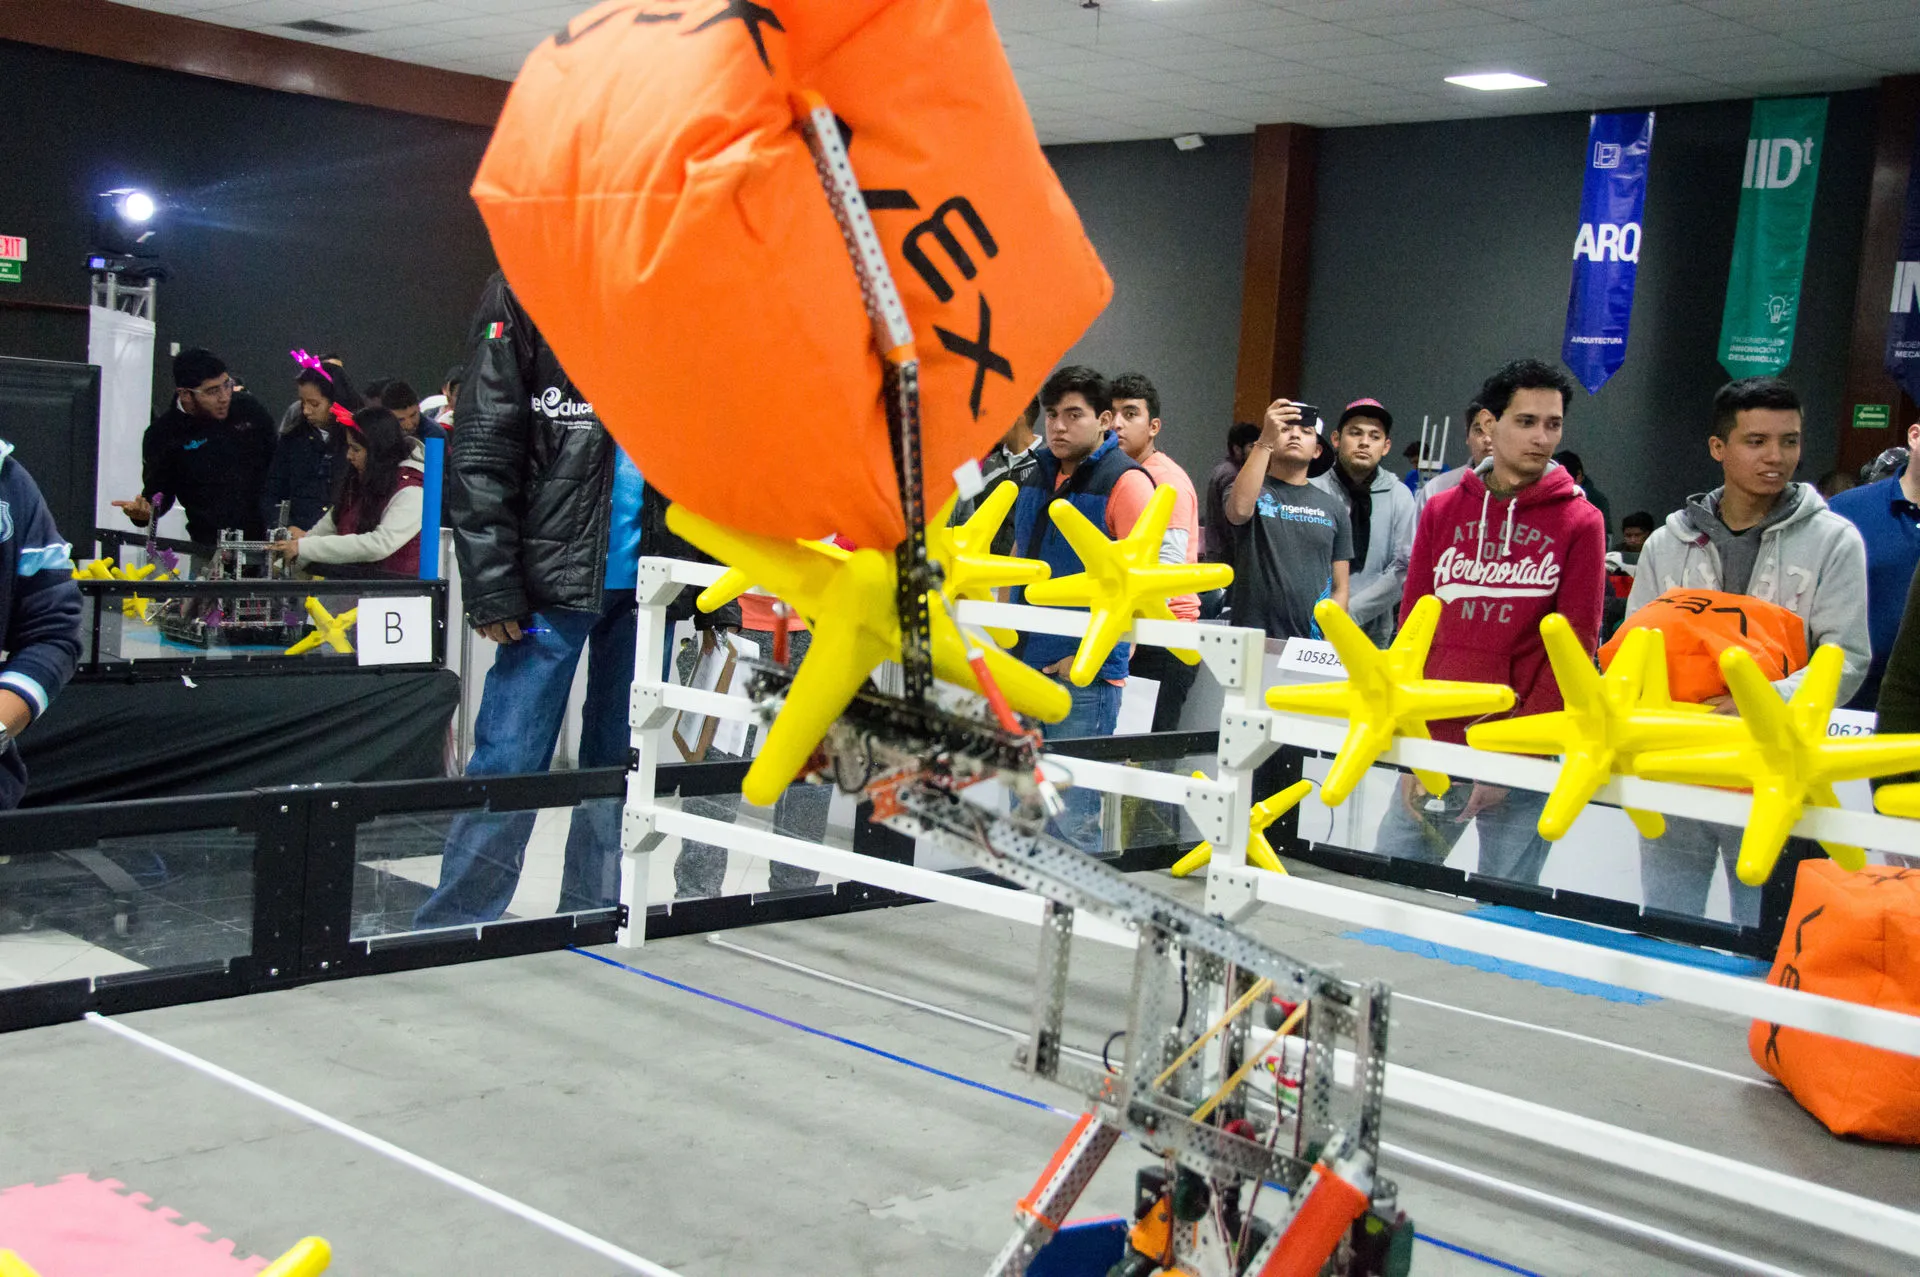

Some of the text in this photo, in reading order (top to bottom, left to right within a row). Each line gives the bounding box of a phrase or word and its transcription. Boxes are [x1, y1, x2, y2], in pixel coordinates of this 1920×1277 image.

[1573, 223, 1642, 265] ARQ
[1571, 336, 1623, 345] ARQUITECTURA
[1498, 520, 1555, 554] DEPT
[1433, 546, 1560, 588] Aéropostale
[385, 611, 404, 645] B
[1461, 601, 1513, 623] NYC
